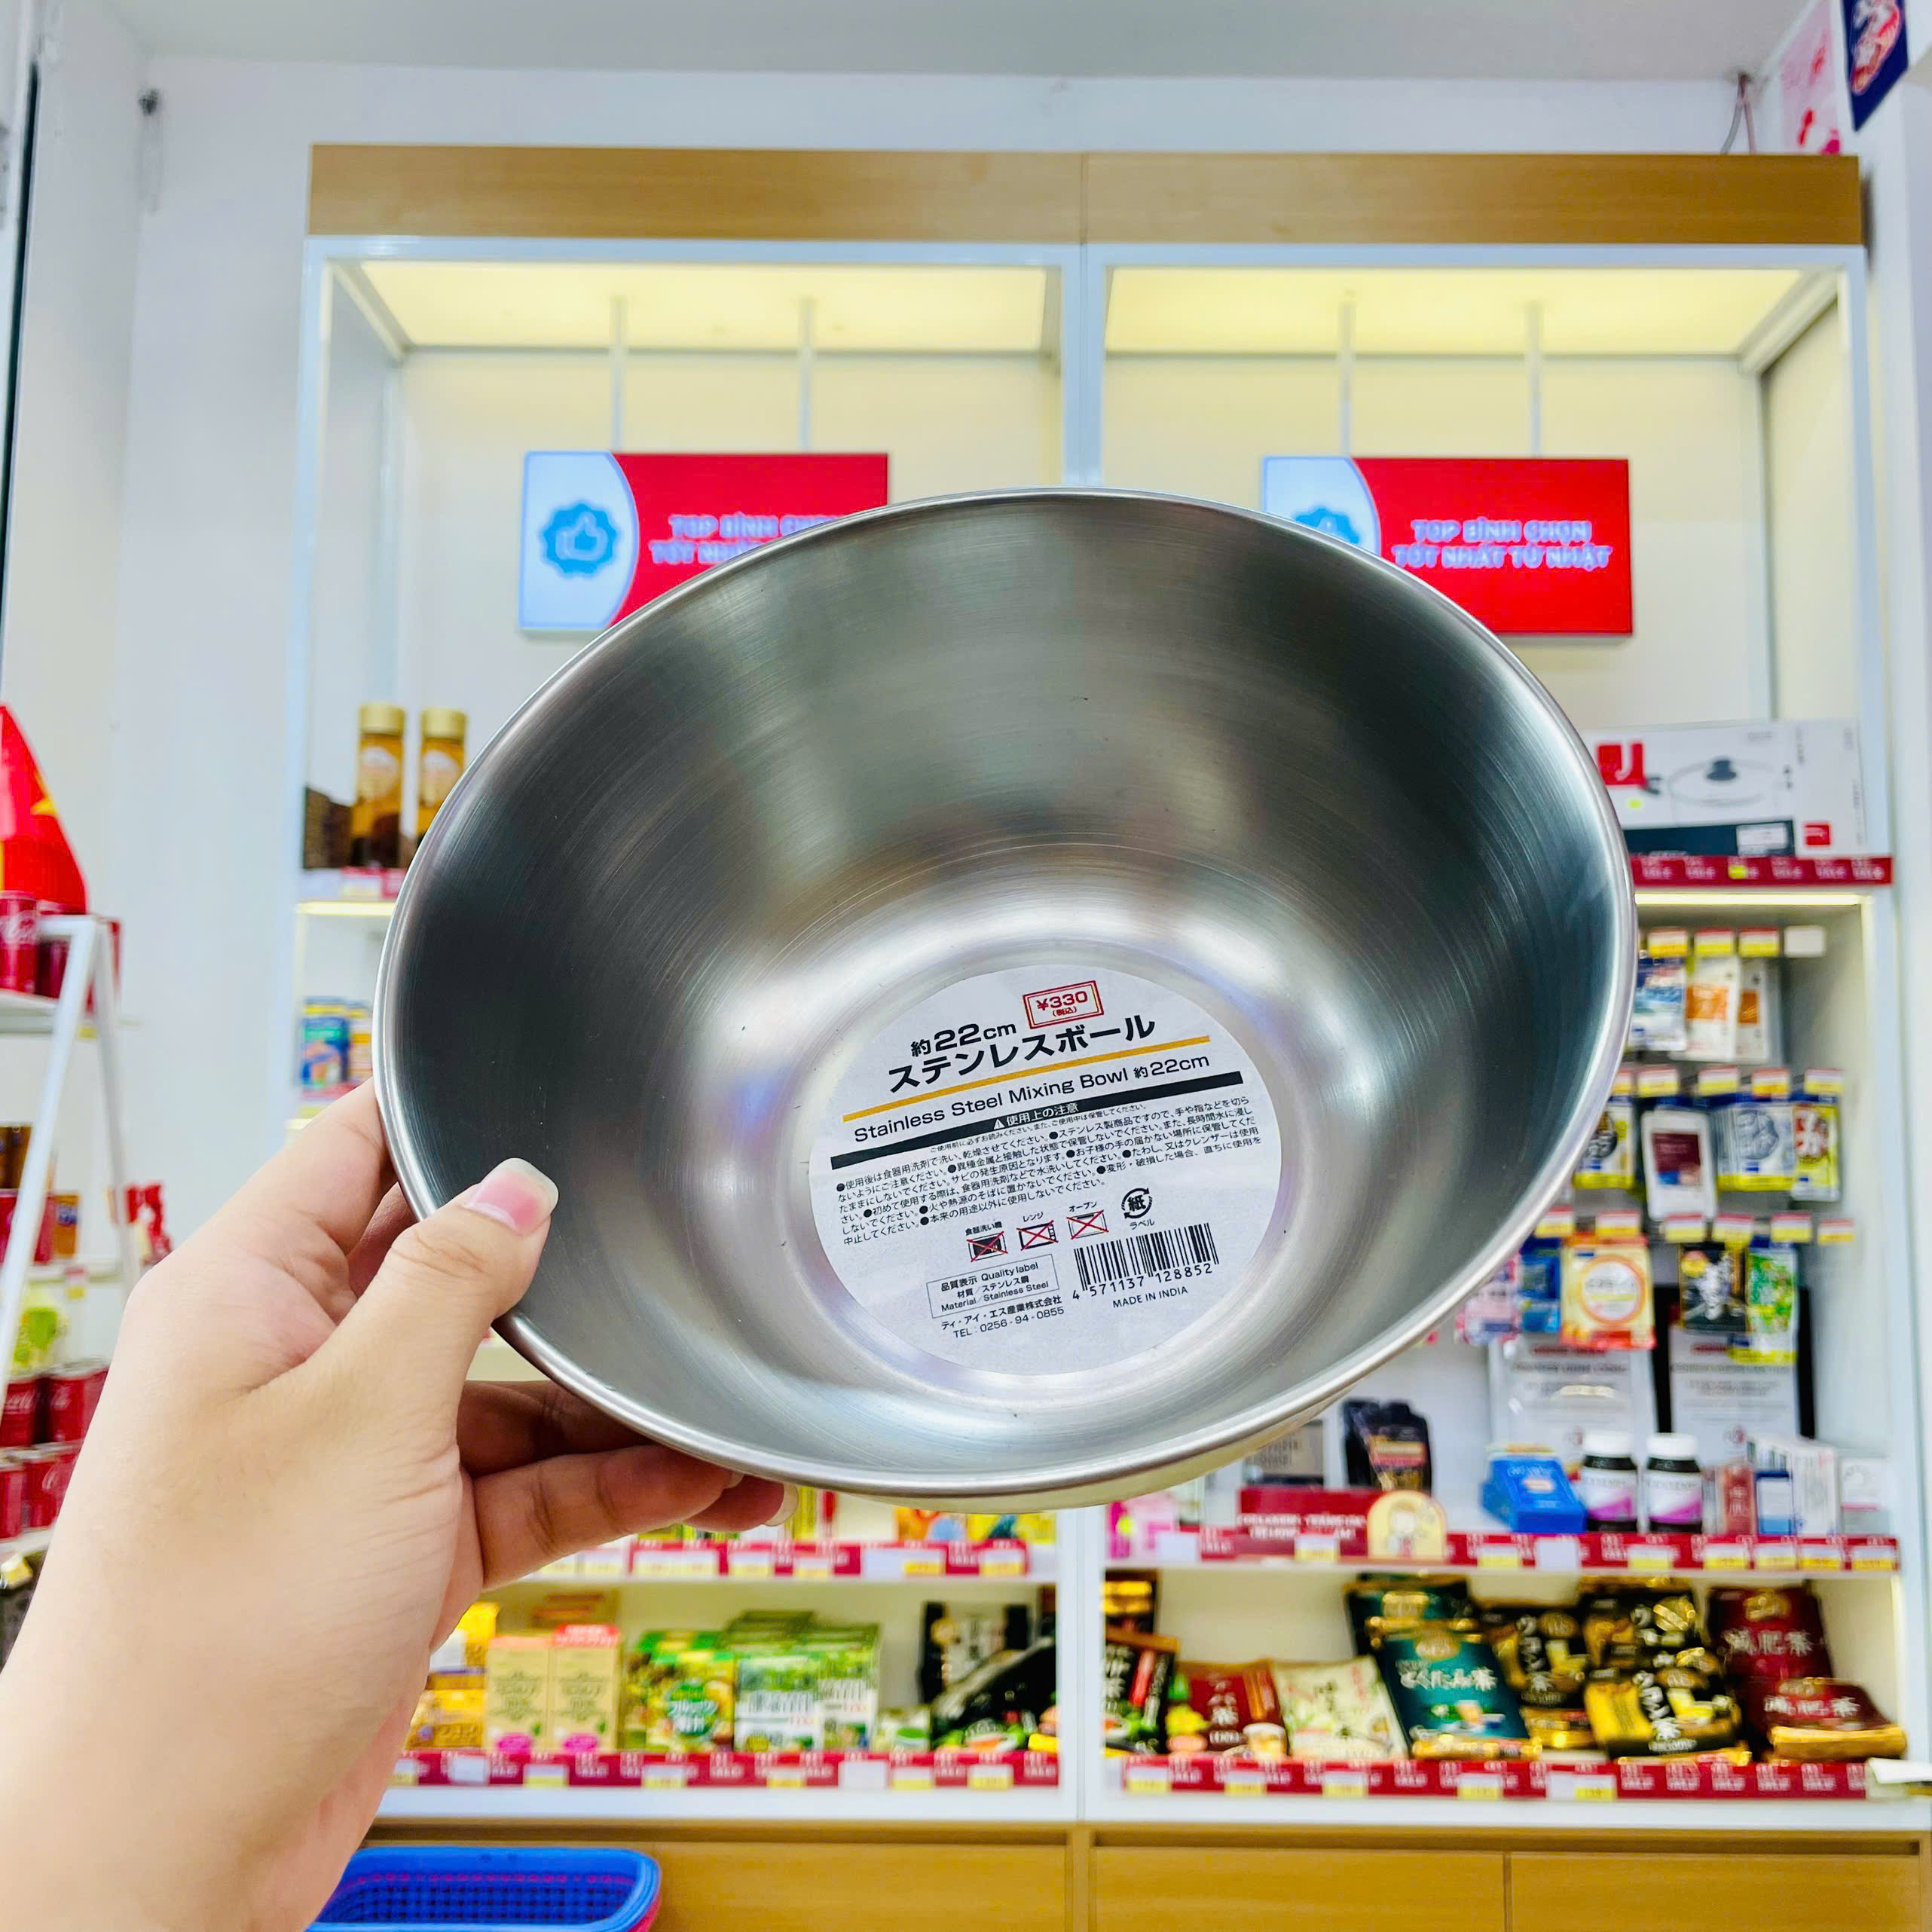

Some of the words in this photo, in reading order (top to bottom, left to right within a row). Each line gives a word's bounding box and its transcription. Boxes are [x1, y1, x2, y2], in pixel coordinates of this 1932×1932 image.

[1411, 520, 1462, 542] TOP
[1463, 516, 1521, 542] BÌNH
[1035, 990, 1088, 1011] ¥330
[910, 1023, 1016, 1057] 約22cm
[888, 1015, 1156, 1093] ステンレスボール
[854, 1110, 945, 1142] Stainless
[951, 1093, 1002, 1117] Steel
[1010, 1079, 1075, 1104] Mixing
[1081, 1068, 1128, 1090] Bowl
[1133, 1056, 1209, 1080] 約22cm
[1023, 1212, 1044, 1222] レンジ
[1130, 1218, 1154, 1230] ラベル
[981, 1267, 1014, 1281] Quality
[1016, 1262, 1038, 1273] label
[1073, 1290, 1080, 1300] 4
[1090, 1276, 1144, 1297] 571137
[1155, 1263, 1212, 1282] 128852
[1026, 1281, 1049, 1292] Steel
[1113, 1295, 1143, 1308] MADE
[1145, 1292, 1157, 1302] IN
[1159, 1286, 1188, 1298] INDIA
